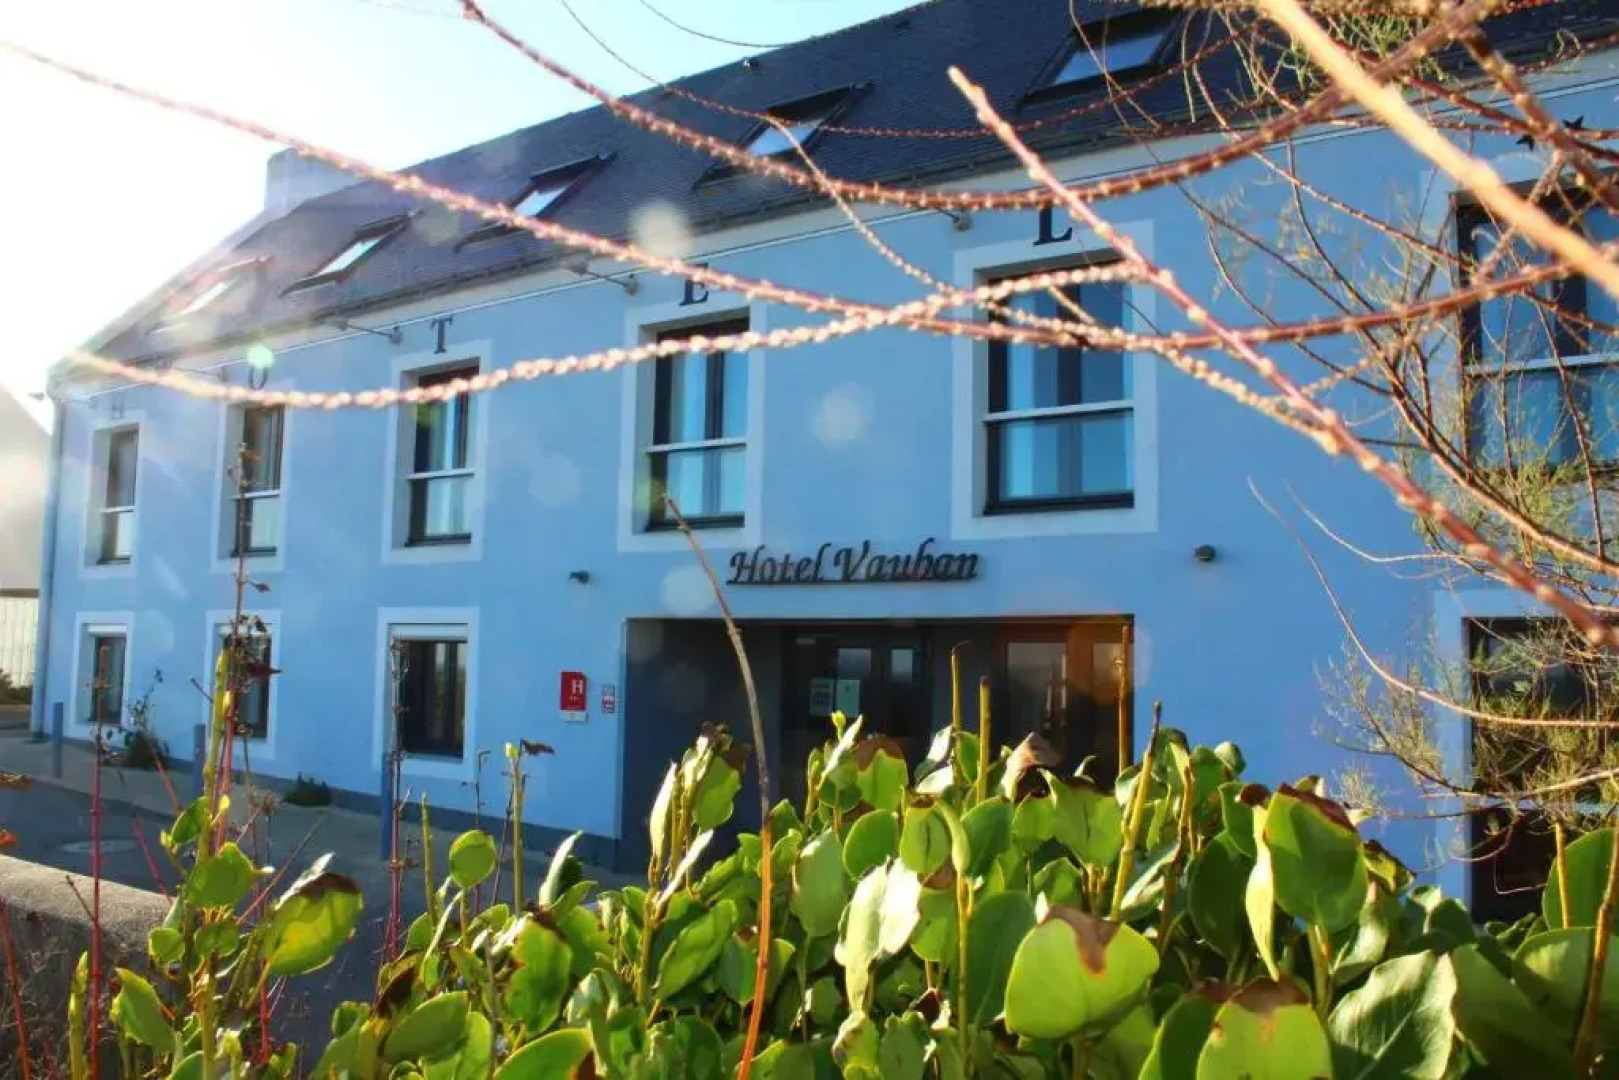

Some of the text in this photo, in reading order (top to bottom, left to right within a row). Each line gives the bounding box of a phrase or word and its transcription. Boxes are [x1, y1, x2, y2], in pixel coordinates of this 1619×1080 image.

[430, 314, 454, 355] T
[1032, 198, 1073, 247] L
[727, 537, 980, 583] Hotel Vauban
[571, 679, 584, 695] H
